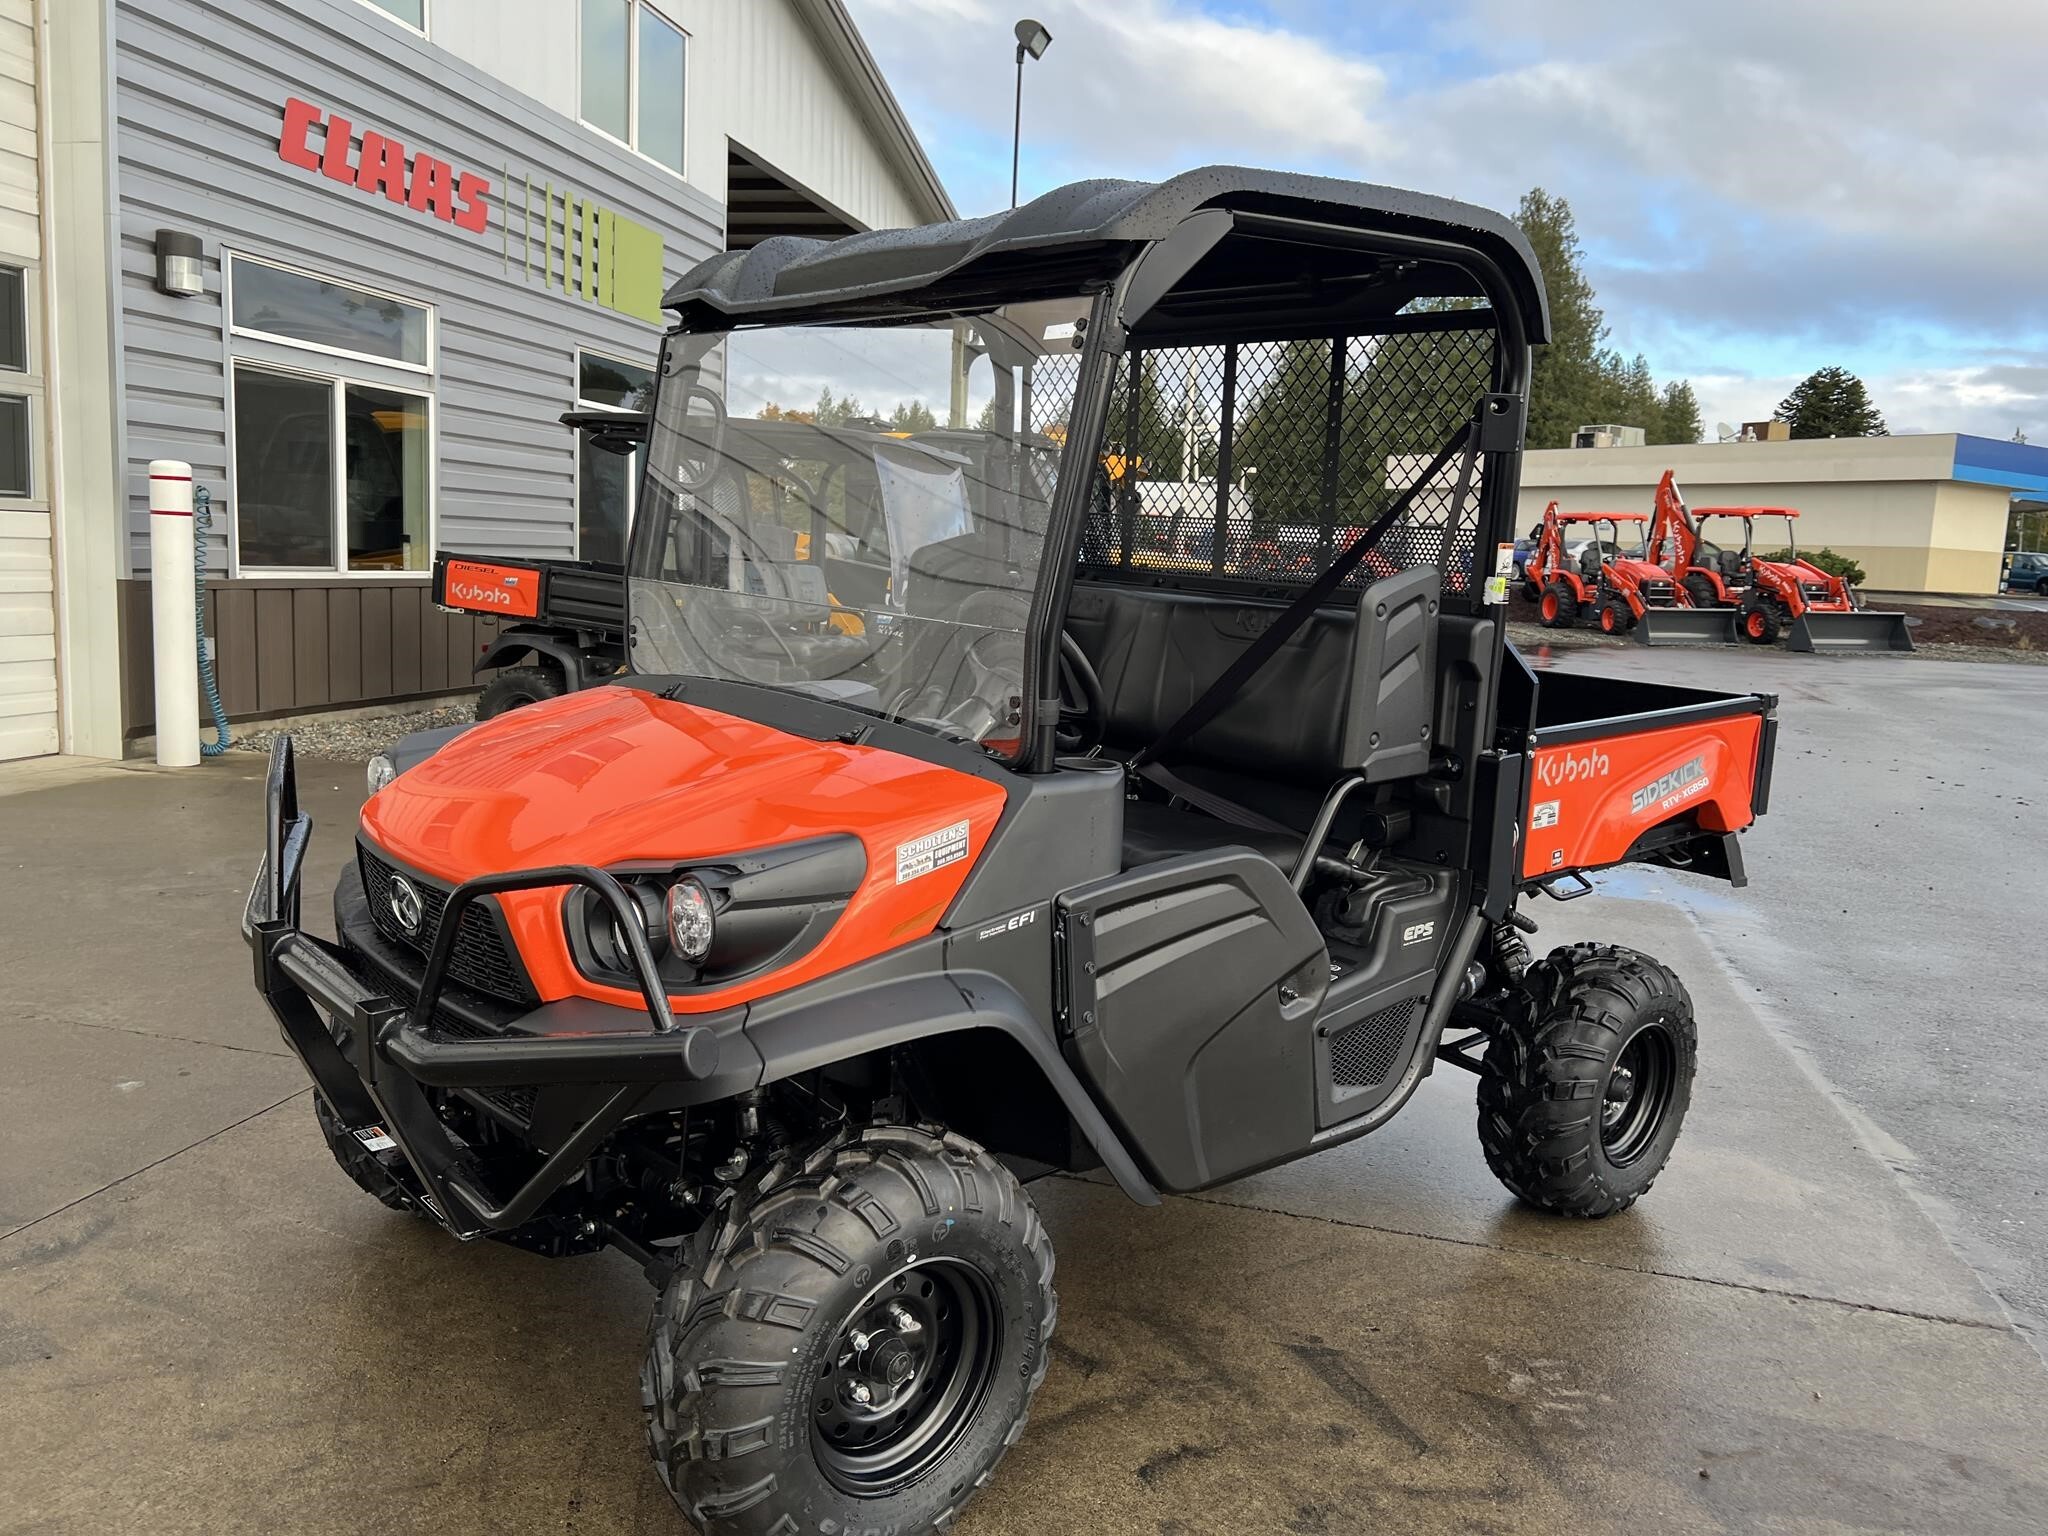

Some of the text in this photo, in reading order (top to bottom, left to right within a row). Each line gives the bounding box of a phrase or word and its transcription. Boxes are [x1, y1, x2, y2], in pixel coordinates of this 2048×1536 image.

[278, 97, 490, 234] CLAAS
[454, 563, 499, 575] DIESEL
[451, 582, 511, 605] Kubota
[1538, 748, 1609, 786] Kubota
[1631, 755, 1705, 814] SIDEKICK
[1662, 776, 1710, 811] RTV-XG850
[900, 823, 967, 860] SCHOLTEN'S
[1008, 910, 1035, 930] EFI
[1403, 921, 1435, 941] EPS
